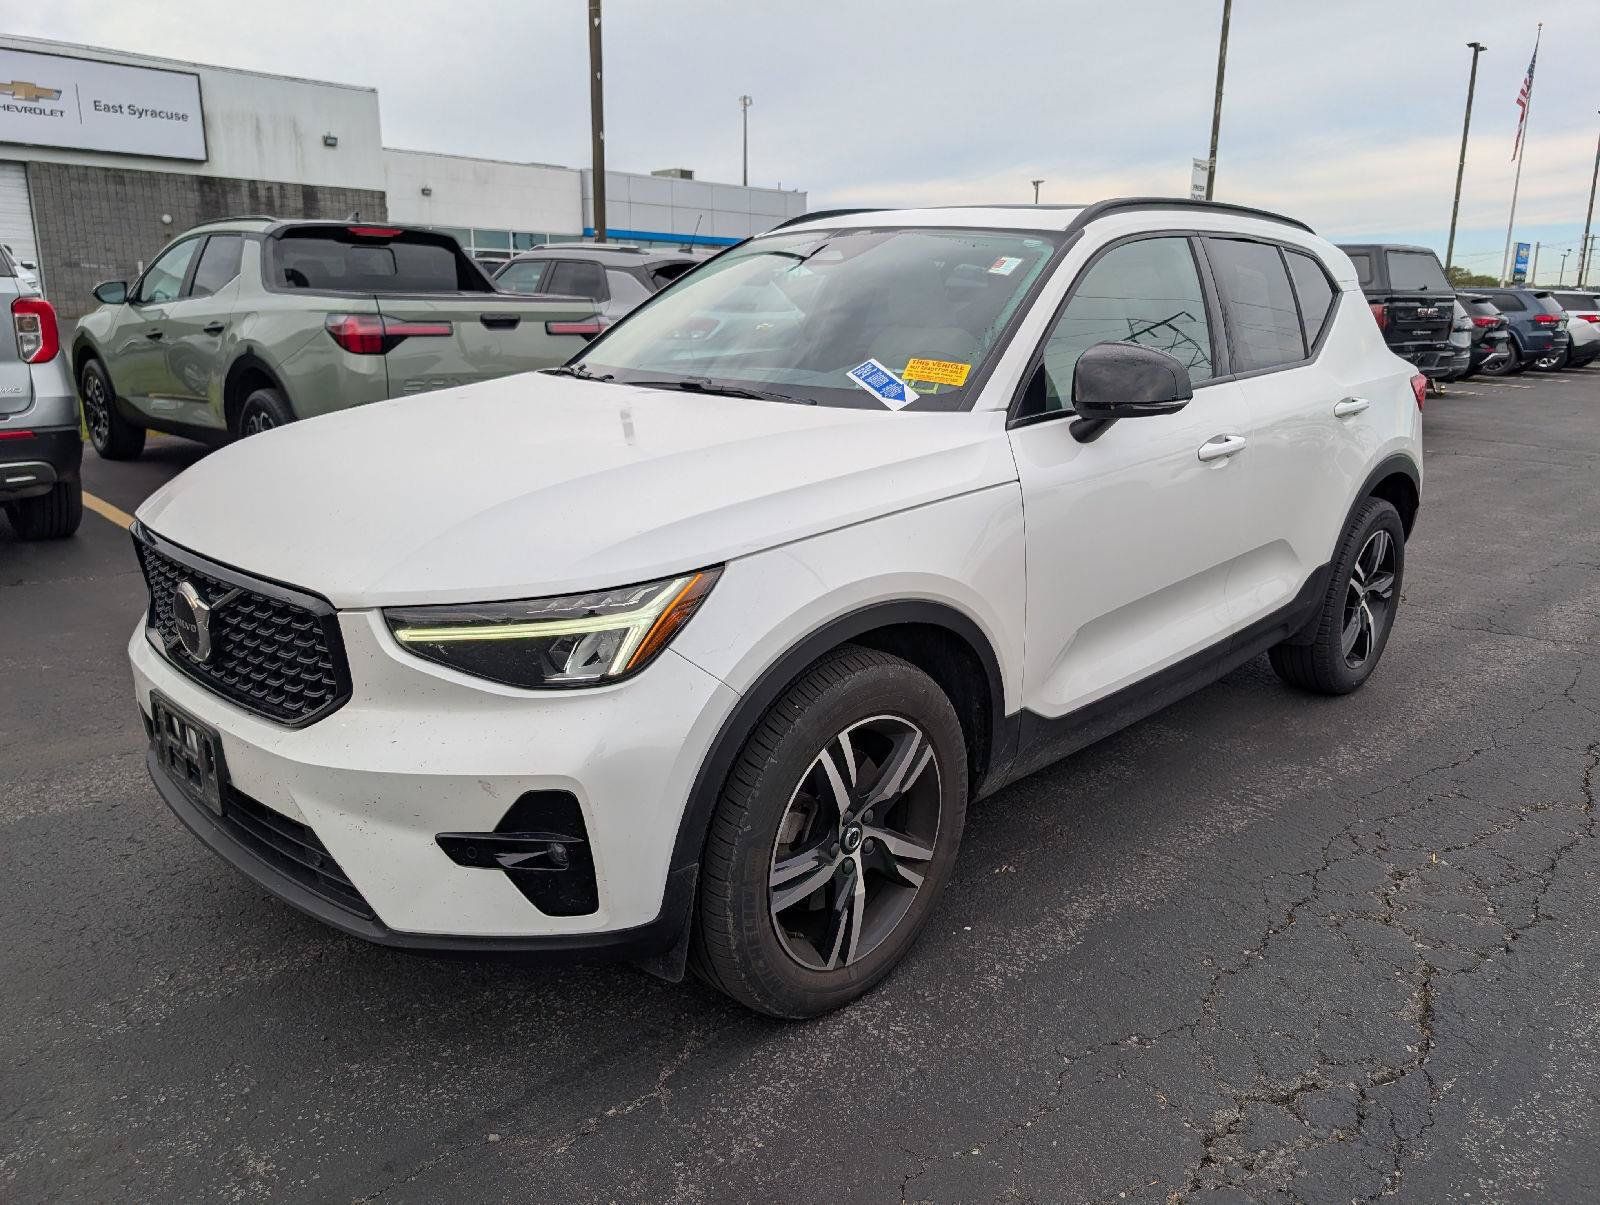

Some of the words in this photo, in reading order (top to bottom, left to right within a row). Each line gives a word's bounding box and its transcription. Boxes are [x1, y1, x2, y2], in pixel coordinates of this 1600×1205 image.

[0, 104, 64, 118] HEVROLET
[94, 100, 124, 115] East
[128, 104, 189, 122] Syracuse
[912, 359, 929, 367] THIS
[932, 361, 965, 371] VEHICLE
